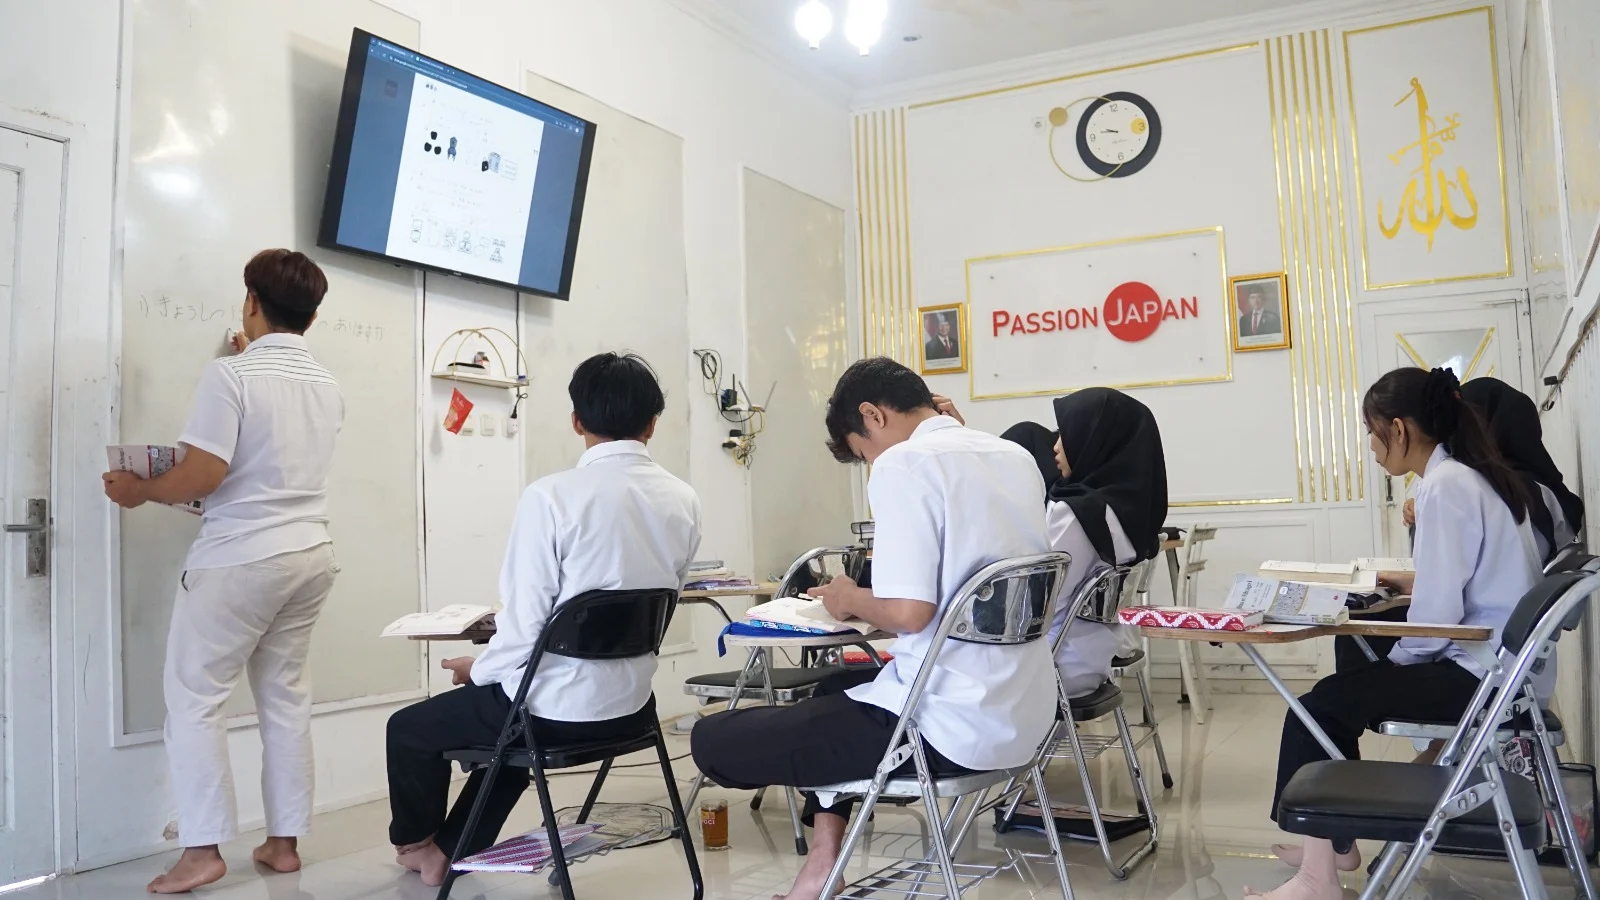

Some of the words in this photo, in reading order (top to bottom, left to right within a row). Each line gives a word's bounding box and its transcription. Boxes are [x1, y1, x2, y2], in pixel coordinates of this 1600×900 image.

[1109, 103, 1119, 112] 12
[1089, 133, 1096, 142] 9
[1138, 122, 1145, 131] 3
[1117, 152, 1124, 161] 6
[992, 306, 1098, 337] PASSION
[1107, 296, 1199, 327] JAPAN
